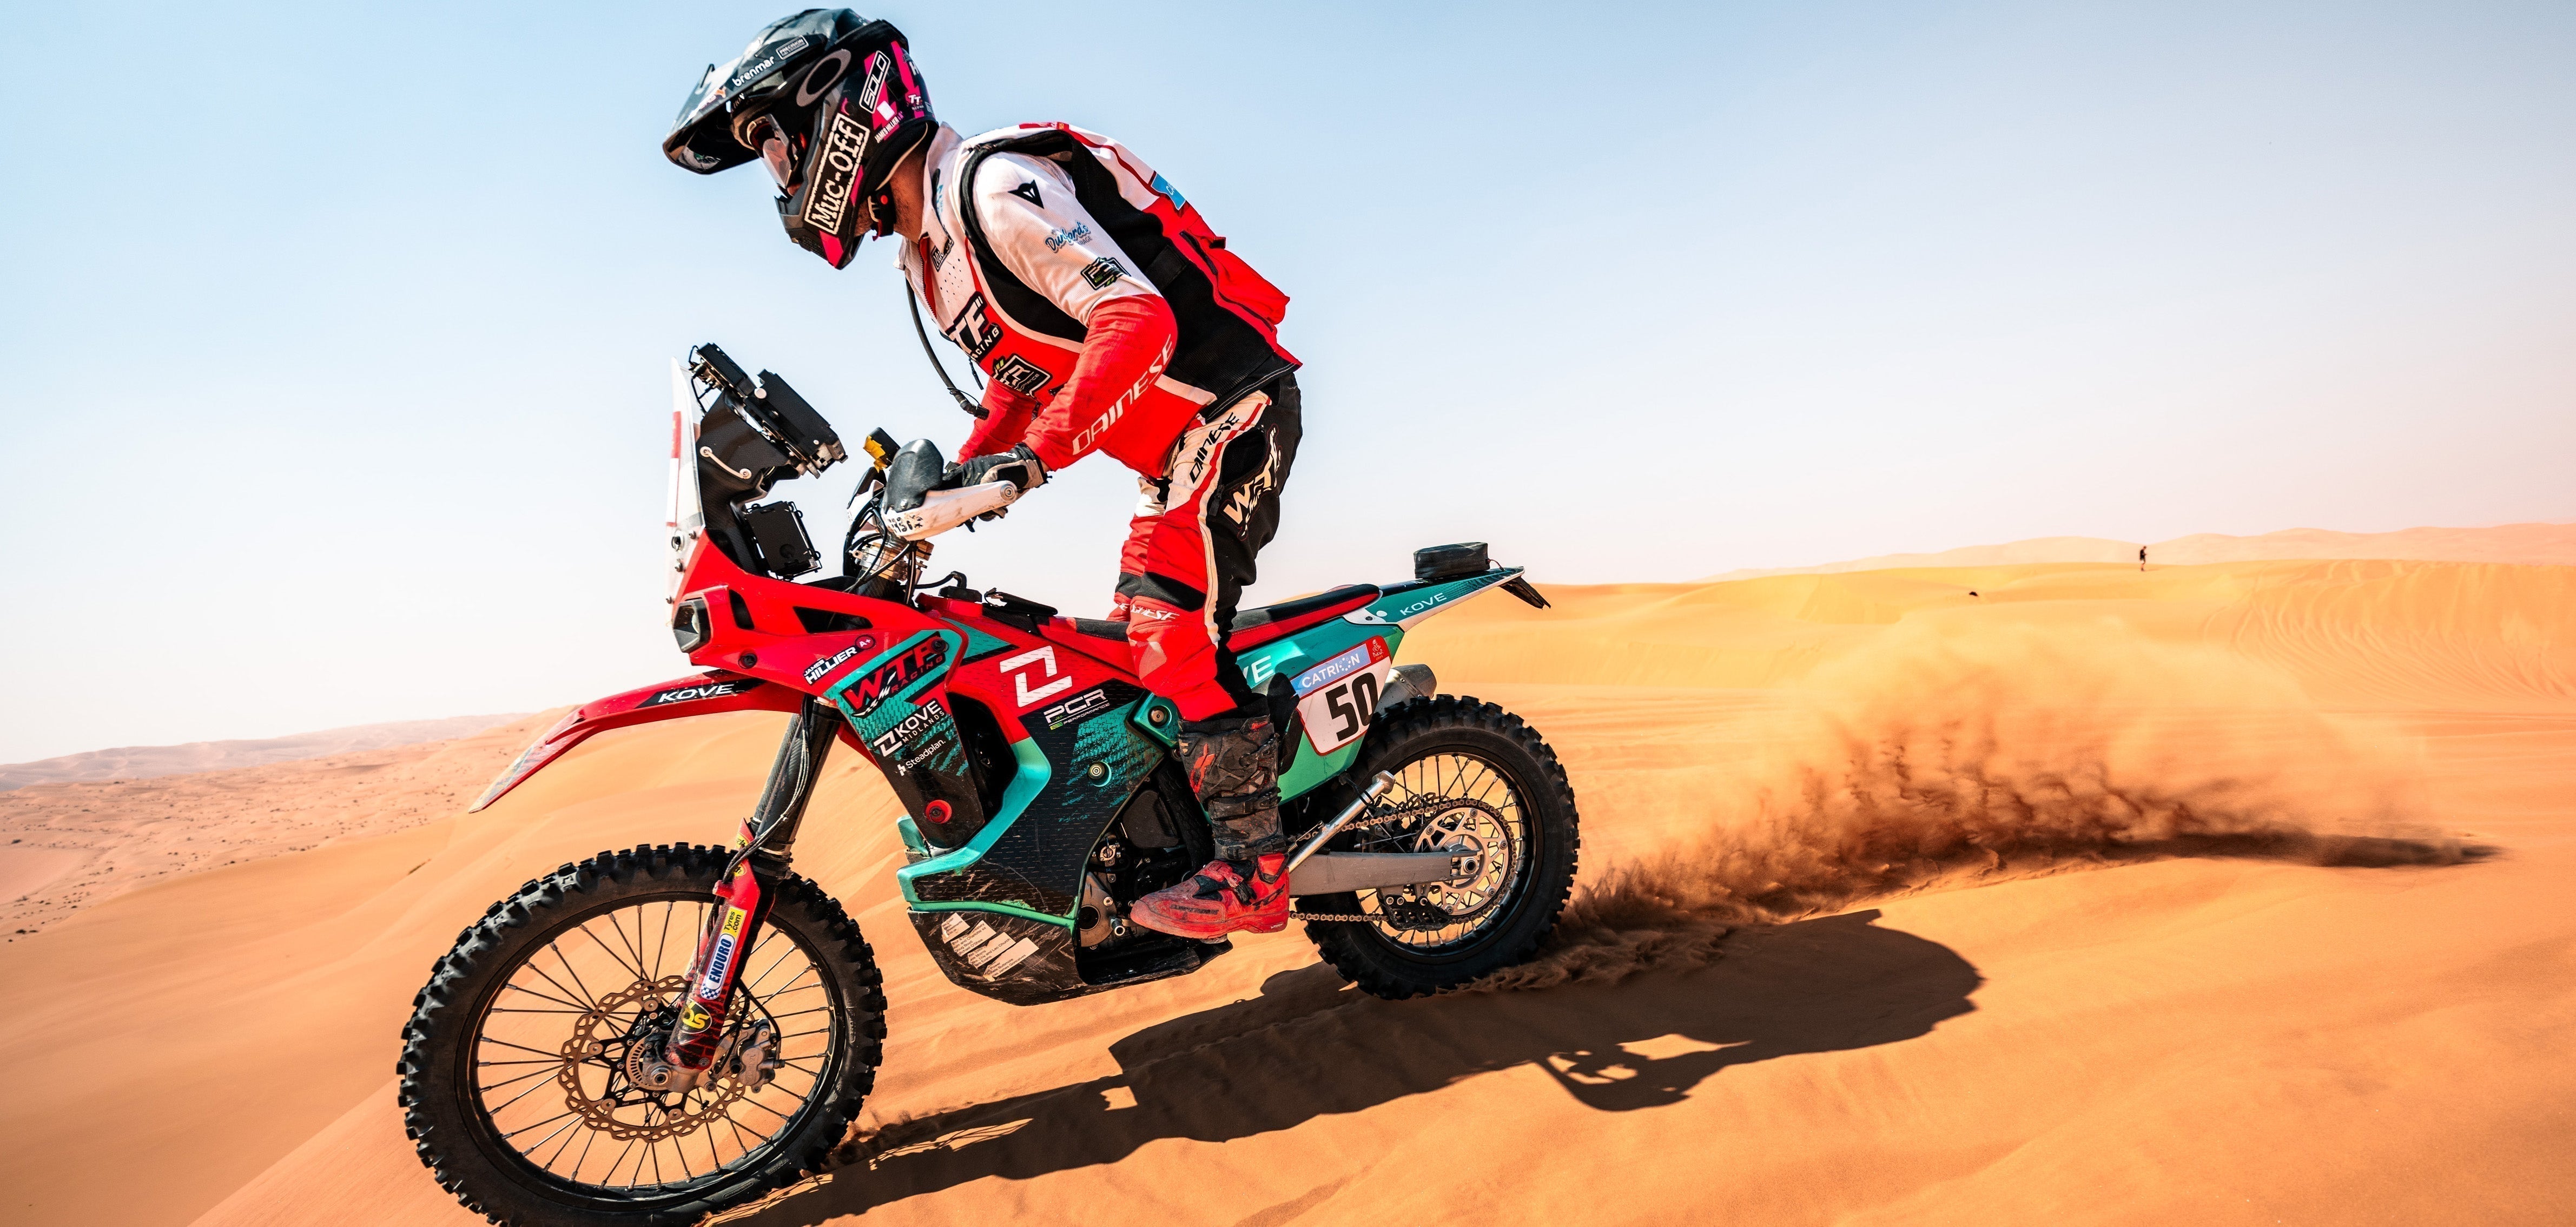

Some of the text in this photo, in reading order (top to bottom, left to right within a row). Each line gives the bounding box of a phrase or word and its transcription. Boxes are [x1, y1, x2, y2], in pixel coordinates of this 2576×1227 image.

[732, 56, 774, 87] brenmar
[864, 54, 887, 109] SOLO
[884, 116, 900, 132] HILLIER
[812, 120, 864, 228] Muc-Off
[1045, 221, 1089, 252] Dunford's
[1072, 334, 1174, 456] DAINESE
[1190, 412, 1239, 484] DAINESE
[1400, 593, 1446, 615] KOVE
[804, 659, 825, 676] JAMES
[805, 647, 857, 684] HILLIER
[892, 655, 942, 693] RACING
[658, 684, 735, 703] KOVE
[1043, 689, 1107, 723] PCR
[1325, 672, 1379, 742] 50
[894, 701, 941, 737] KOVE
[902, 711, 944, 743] MIDLANDS
[1063, 702, 1109, 725] PERFORMANCE
[906, 740, 946, 768] Steadplan.
[724, 911, 735, 931] Tyres
[732, 914, 742, 933] .com
[709, 938, 731, 984] ENDURO
